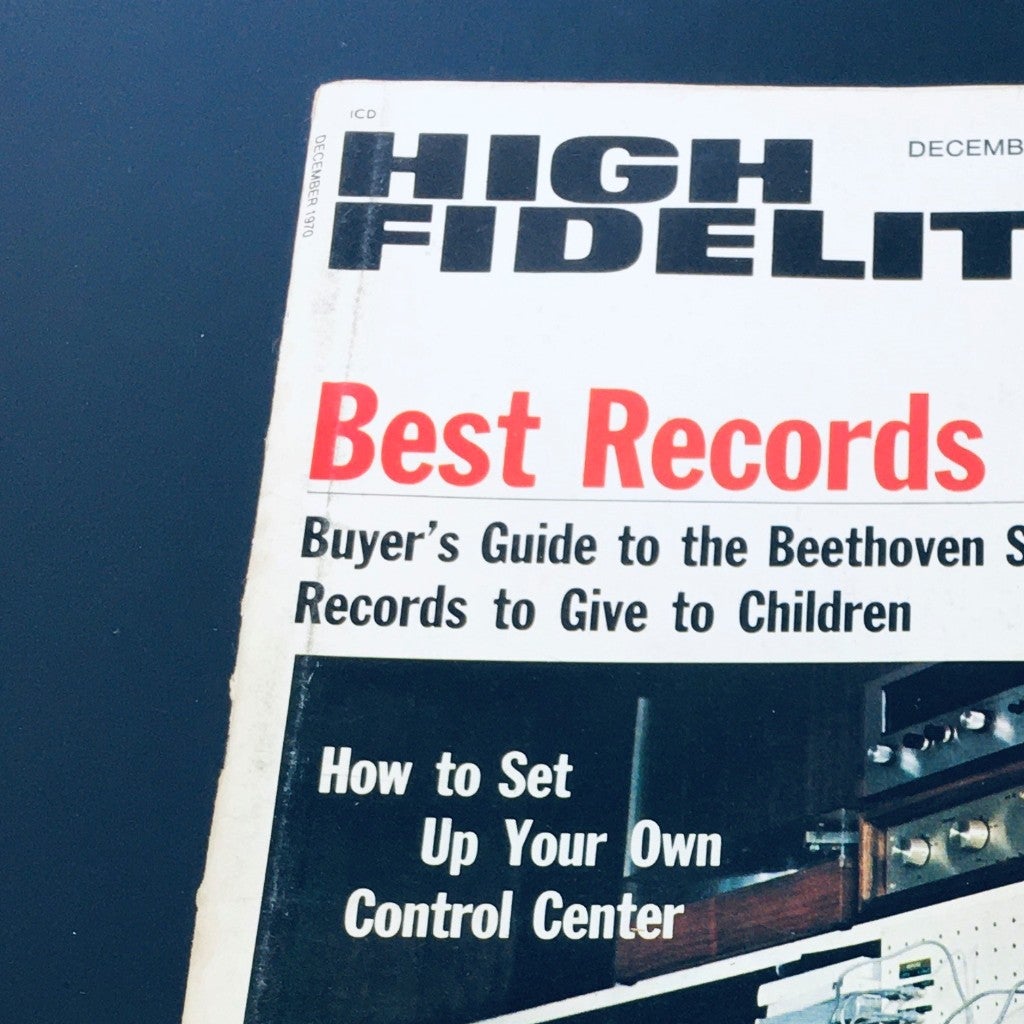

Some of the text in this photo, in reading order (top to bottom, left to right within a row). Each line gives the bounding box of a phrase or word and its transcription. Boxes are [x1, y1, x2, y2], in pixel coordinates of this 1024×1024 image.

[350, 109, 377, 119] ICD
[302, 134, 327, 238] DECEMBER 1970
[338, 131, 813, 204] HIGH
[309, 382, 540, 487] Best
[583, 388, 985, 492] Records
[301, 516, 459, 569] Buyer's
[482, 522, 597, 565] Guide
[618, 526, 659, 566] to
[682, 525, 747, 567] the
[769, 526, 984, 567] Beethoven
[295, 581, 910, 633] Records to Give to Children
[319, 746, 573, 798] How to Set
[421, 817, 723, 876] Up Your Own
[345, 888, 685, 941] Control Center
